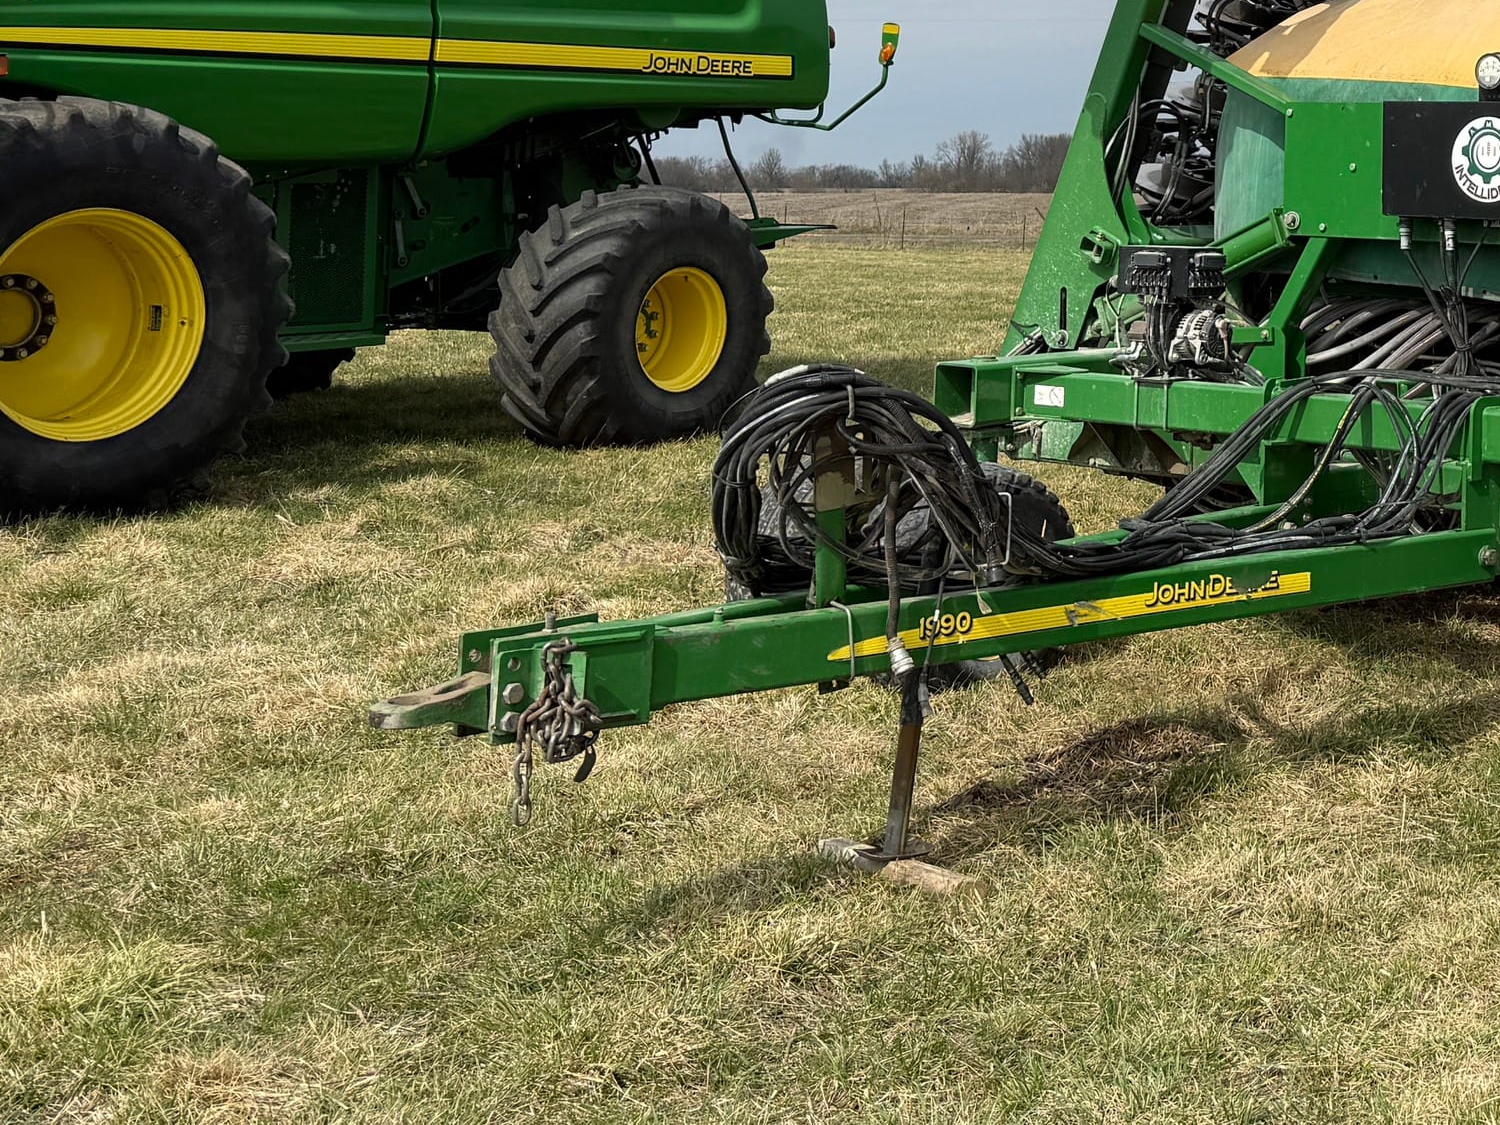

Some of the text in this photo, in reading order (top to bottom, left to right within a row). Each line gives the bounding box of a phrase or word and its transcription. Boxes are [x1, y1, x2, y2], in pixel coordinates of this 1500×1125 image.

[641, 53, 754, 75] JOHN DEERE
[1145, 570, 1280, 607] JOHN DEE
[919, 611, 973, 639] 1990
